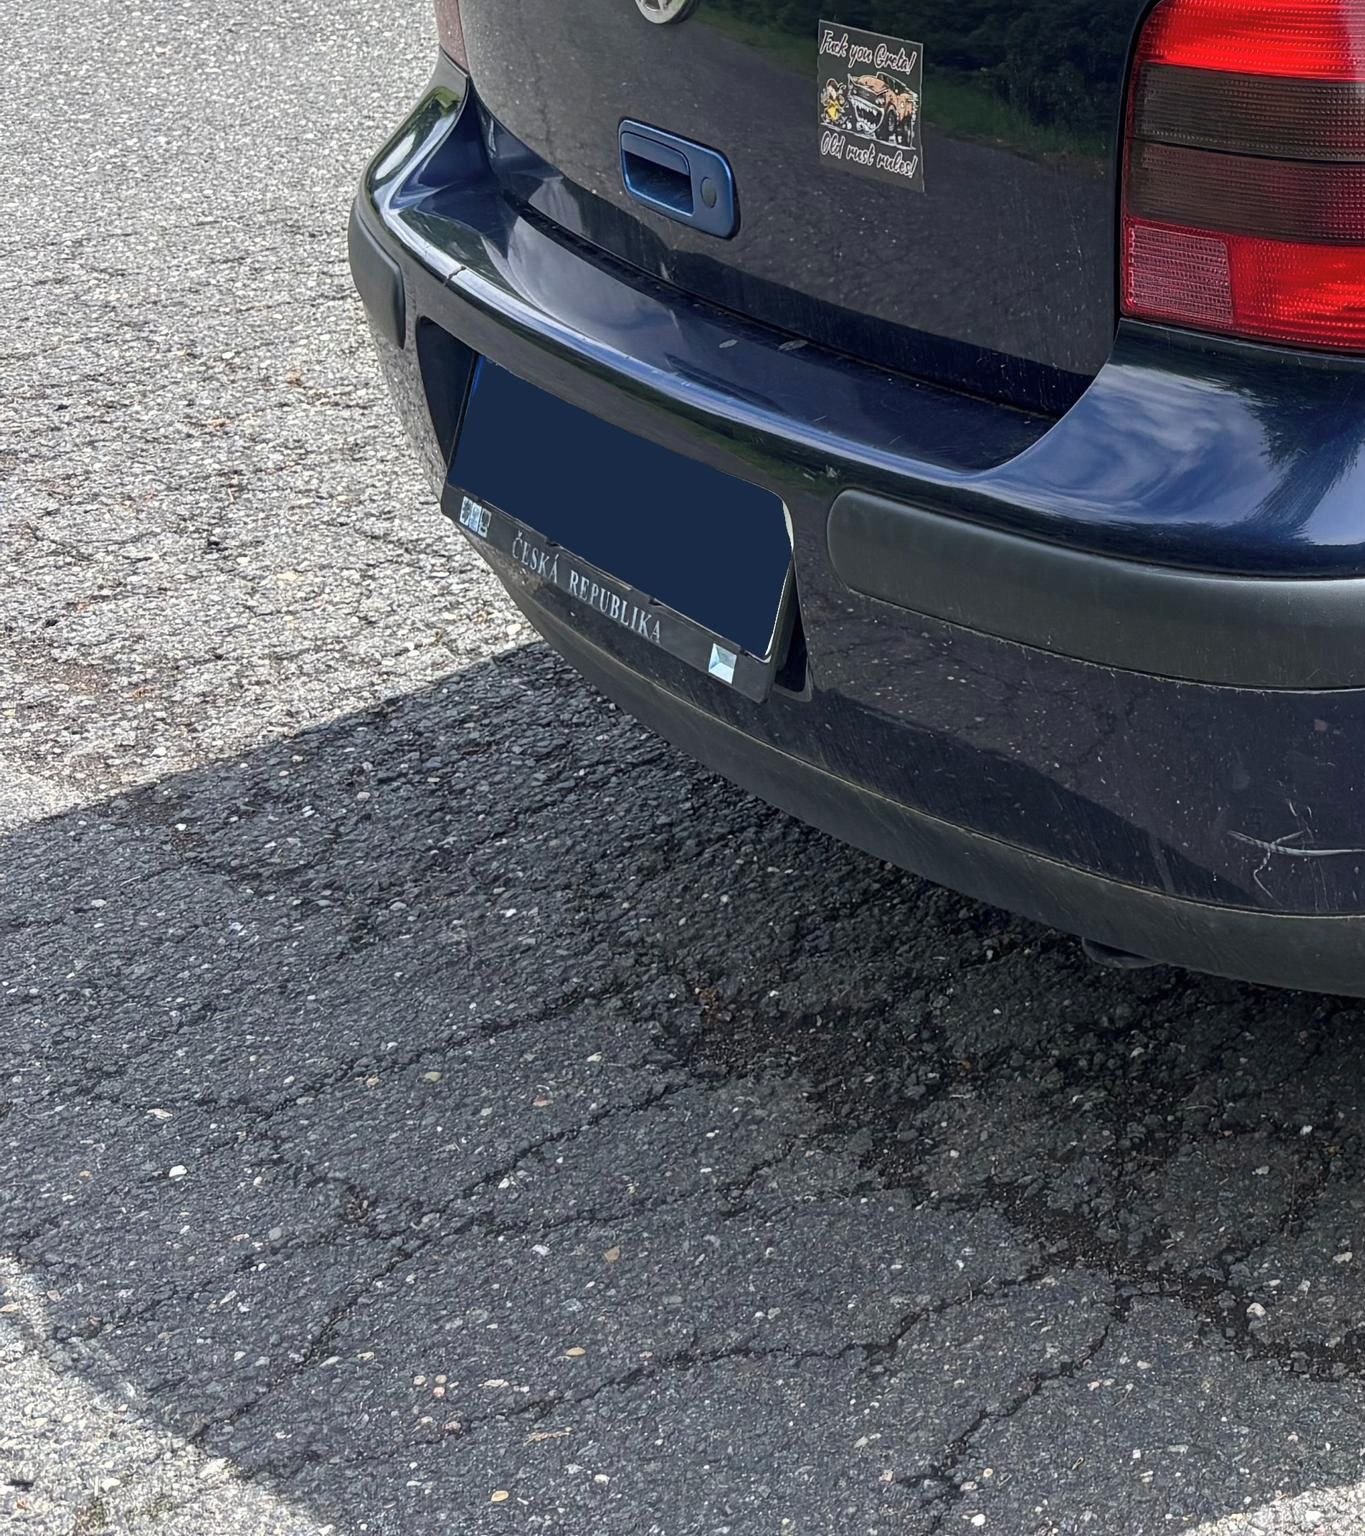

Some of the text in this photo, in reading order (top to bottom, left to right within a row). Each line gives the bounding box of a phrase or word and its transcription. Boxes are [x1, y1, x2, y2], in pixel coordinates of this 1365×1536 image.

[820, 29, 918, 76] Fuck you Greta!
[821, 130, 919, 178] Old rust rules!
[511, 529, 661, 645] ČESKÁ REPUBLIKA
